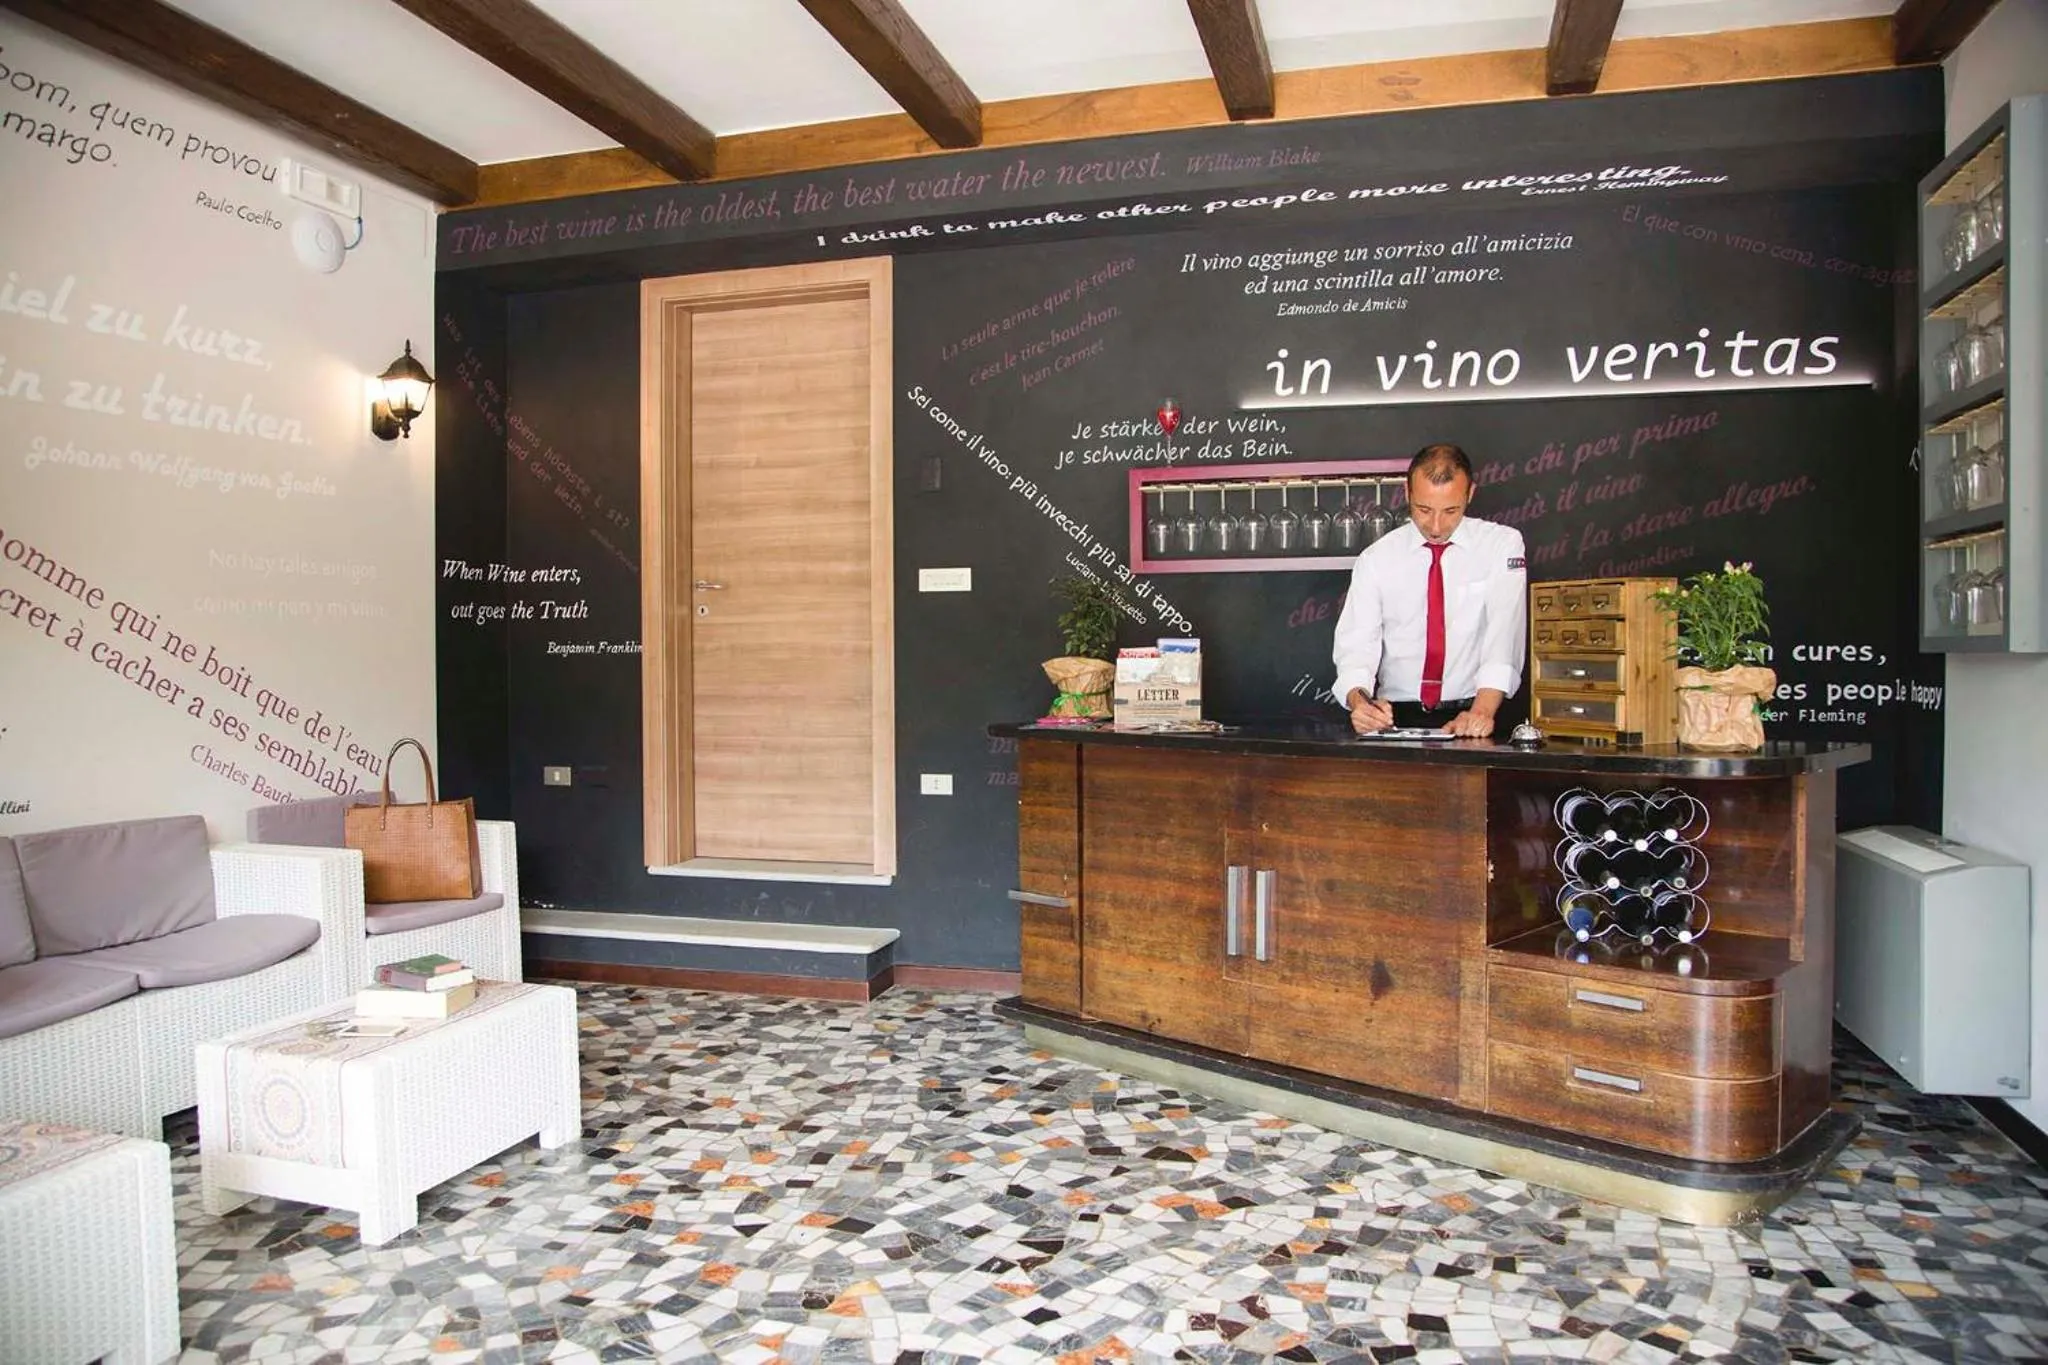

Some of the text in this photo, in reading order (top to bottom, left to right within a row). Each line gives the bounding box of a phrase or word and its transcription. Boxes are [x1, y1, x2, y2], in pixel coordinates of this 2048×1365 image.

[90, 102, 175, 147] quem
[181, 133, 277, 183] provou
[451, 145, 1321, 255] The best wine is the oldest, the best water the newest. William Blake
[817, 164, 1692, 247] I drink to make other people more interesting.
[1520, 175, 1729, 197] Ernest Hemingway
[196, 191, 283, 230] Paulo Coelho
[1621, 203, 1641, 223] El
[1644, 214, 1680, 236] que
[1683, 223, 1719, 243] con
[1725, 231, 1768, 254] vino
[1181, 234, 1574, 273] Il vino aggiunge un sorriso all'amicizia
[1244, 265, 1505, 296] ed una scintilla all'amore.
[940, 345, 959, 362] La
[961, 320, 1000, 351] seule
[1002, 306, 1040, 331] arme
[1043, 288, 1072, 315] que
[1073, 278, 1089, 302] je
[1276, 296, 1408, 317] Edmondo de Amicis
[85, 301, 148, 342] zu
[162, 302, 273, 372] kurz,
[1003, 350, 1018, 371] le
[1020, 339, 1105, 392] Jean Carmet
[1265, 328, 1840, 398] in vino veritas
[61, 371, 314, 447] zu trinken.
[1071, 413, 1287, 440] Je stärke der Wein,
[24, 435, 123, 471] Johann
[129, 449, 237, 494] Wolfgang
[238, 469, 272, 491] von
[507, 437, 529, 462] und
[530, 459, 553, 486] der
[1054, 438, 1293, 470] je schwächer das Bein.
[1522, 442, 1566, 476] chi
[1571, 431, 1621, 476] per
[907, 386, 933, 409] Sei
[929, 406, 967, 441] come
[966, 434, 984, 451] il
[979, 445, 1012, 479] vino:
[1009, 476, 1038, 500] più
[1035, 494, 1094, 548] invecchi
[1087, 542, 1116, 569] più
[1114, 563, 1136, 585] sai
[1134, 580, 1155, 598] di
[1152, 594, 1193, 637] tappo.
[1555, 480, 1579, 513] il
[1533, 533, 1570, 566] mi
[1577, 521, 1612, 560] fa
[1621, 505, 1694, 542] stare
[208, 548, 238, 570] No
[242, 550, 276, 580] hay
[280, 551, 320, 577] tales
[442, 559, 582, 585] When Wine enters,
[451, 600, 588, 626] out goes the Truth
[1285, 596, 1331, 631] che
[0, 529, 104, 609] omme
[111, 601, 160, 642] qui
[161, 631, 197, 663] ne
[199, 646, 253, 698] boit
[256, 688, 300, 725] que
[304, 711, 331, 744] de
[547, 641, 595, 658] Benjamin
[1792, 644, 1888, 666] cures,
[65, 618, 84, 652] à
[91, 642, 185, 705] cacher
[187, 697, 204, 719] a
[209, 708, 250, 742] ses
[1137, 688, 1180, 701] LETTER
[1291, 673, 1314, 697] il
[1911, 680, 1943, 710] happy
[1799, 709, 1867, 725] Fleming
[190, 745, 249, 786] Charles
